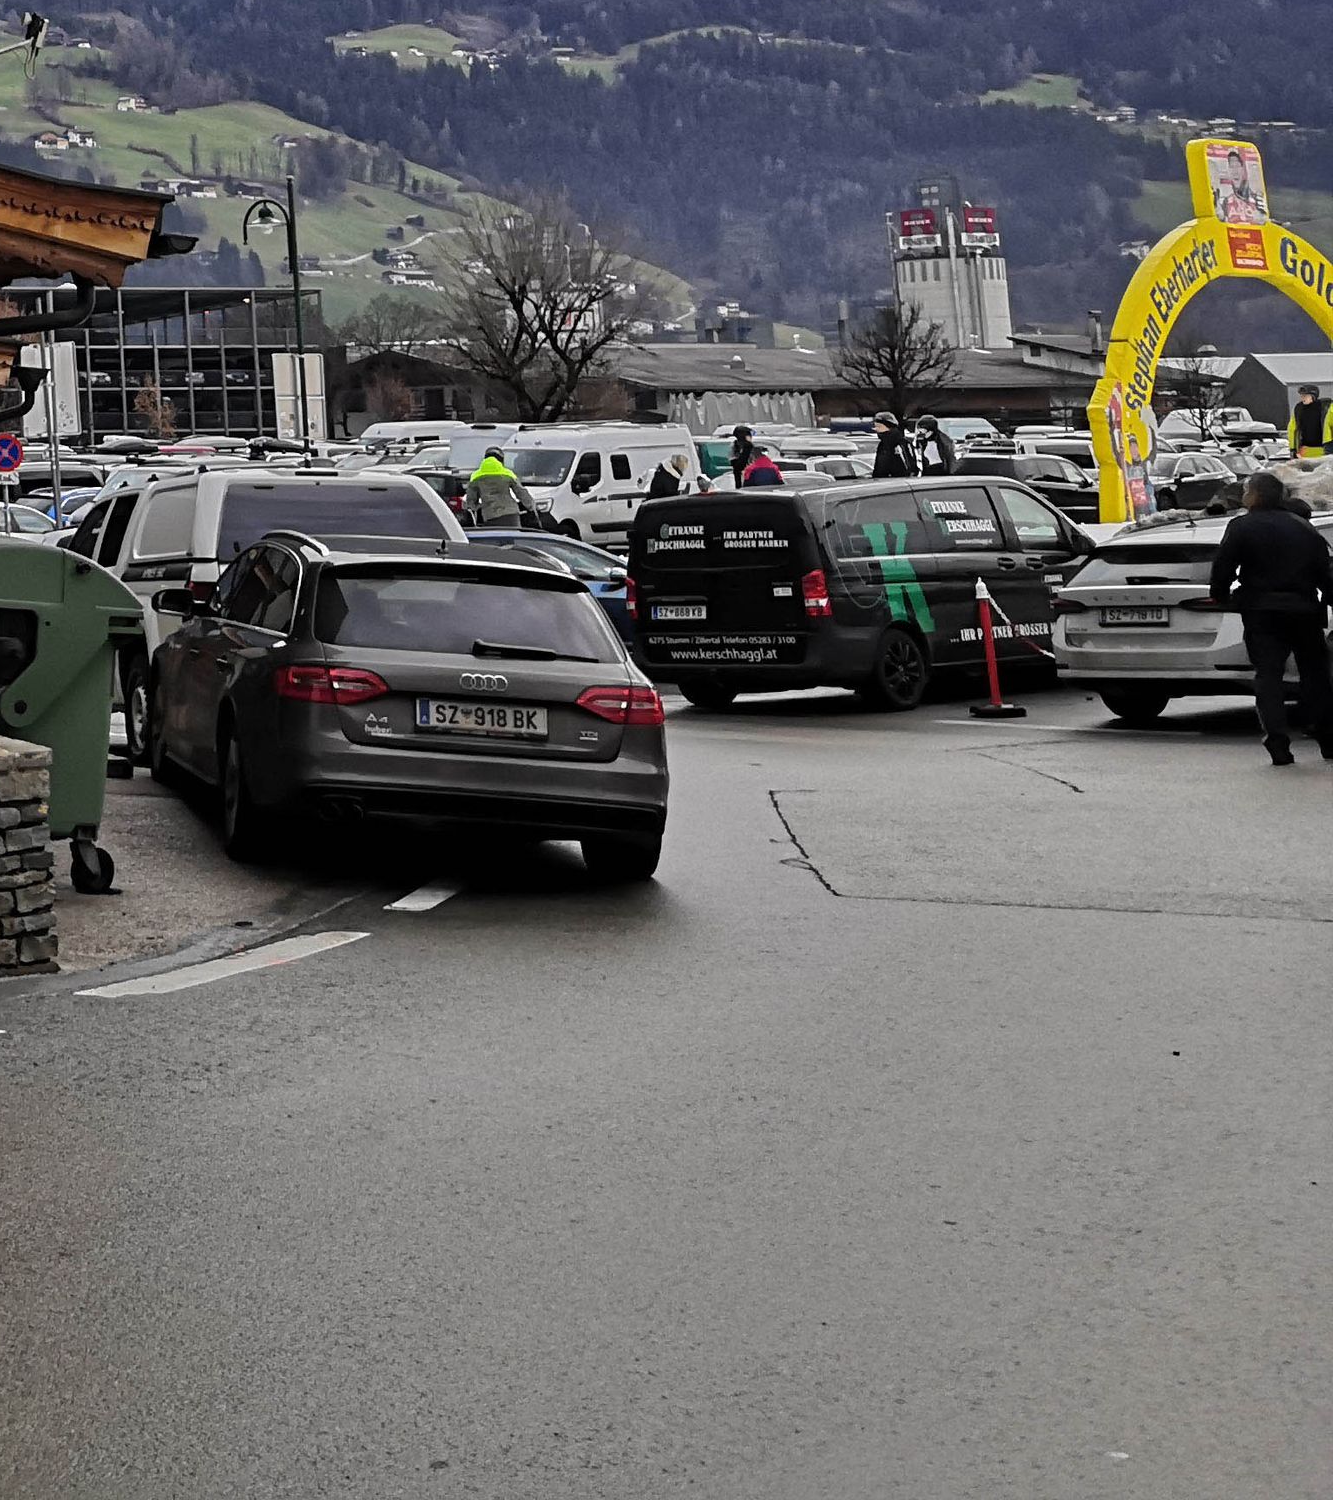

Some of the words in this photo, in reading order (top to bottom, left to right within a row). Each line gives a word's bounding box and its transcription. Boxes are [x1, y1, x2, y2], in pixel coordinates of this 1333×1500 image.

[1125, 313, 1162, 411] Stephan
[738, 531, 774, 539] PARTNER
[977, 625, 1014, 640] PTNER
[671, 649, 778, 662] www.kerschhaggl.at
[436, 705, 459, 724] SZ
